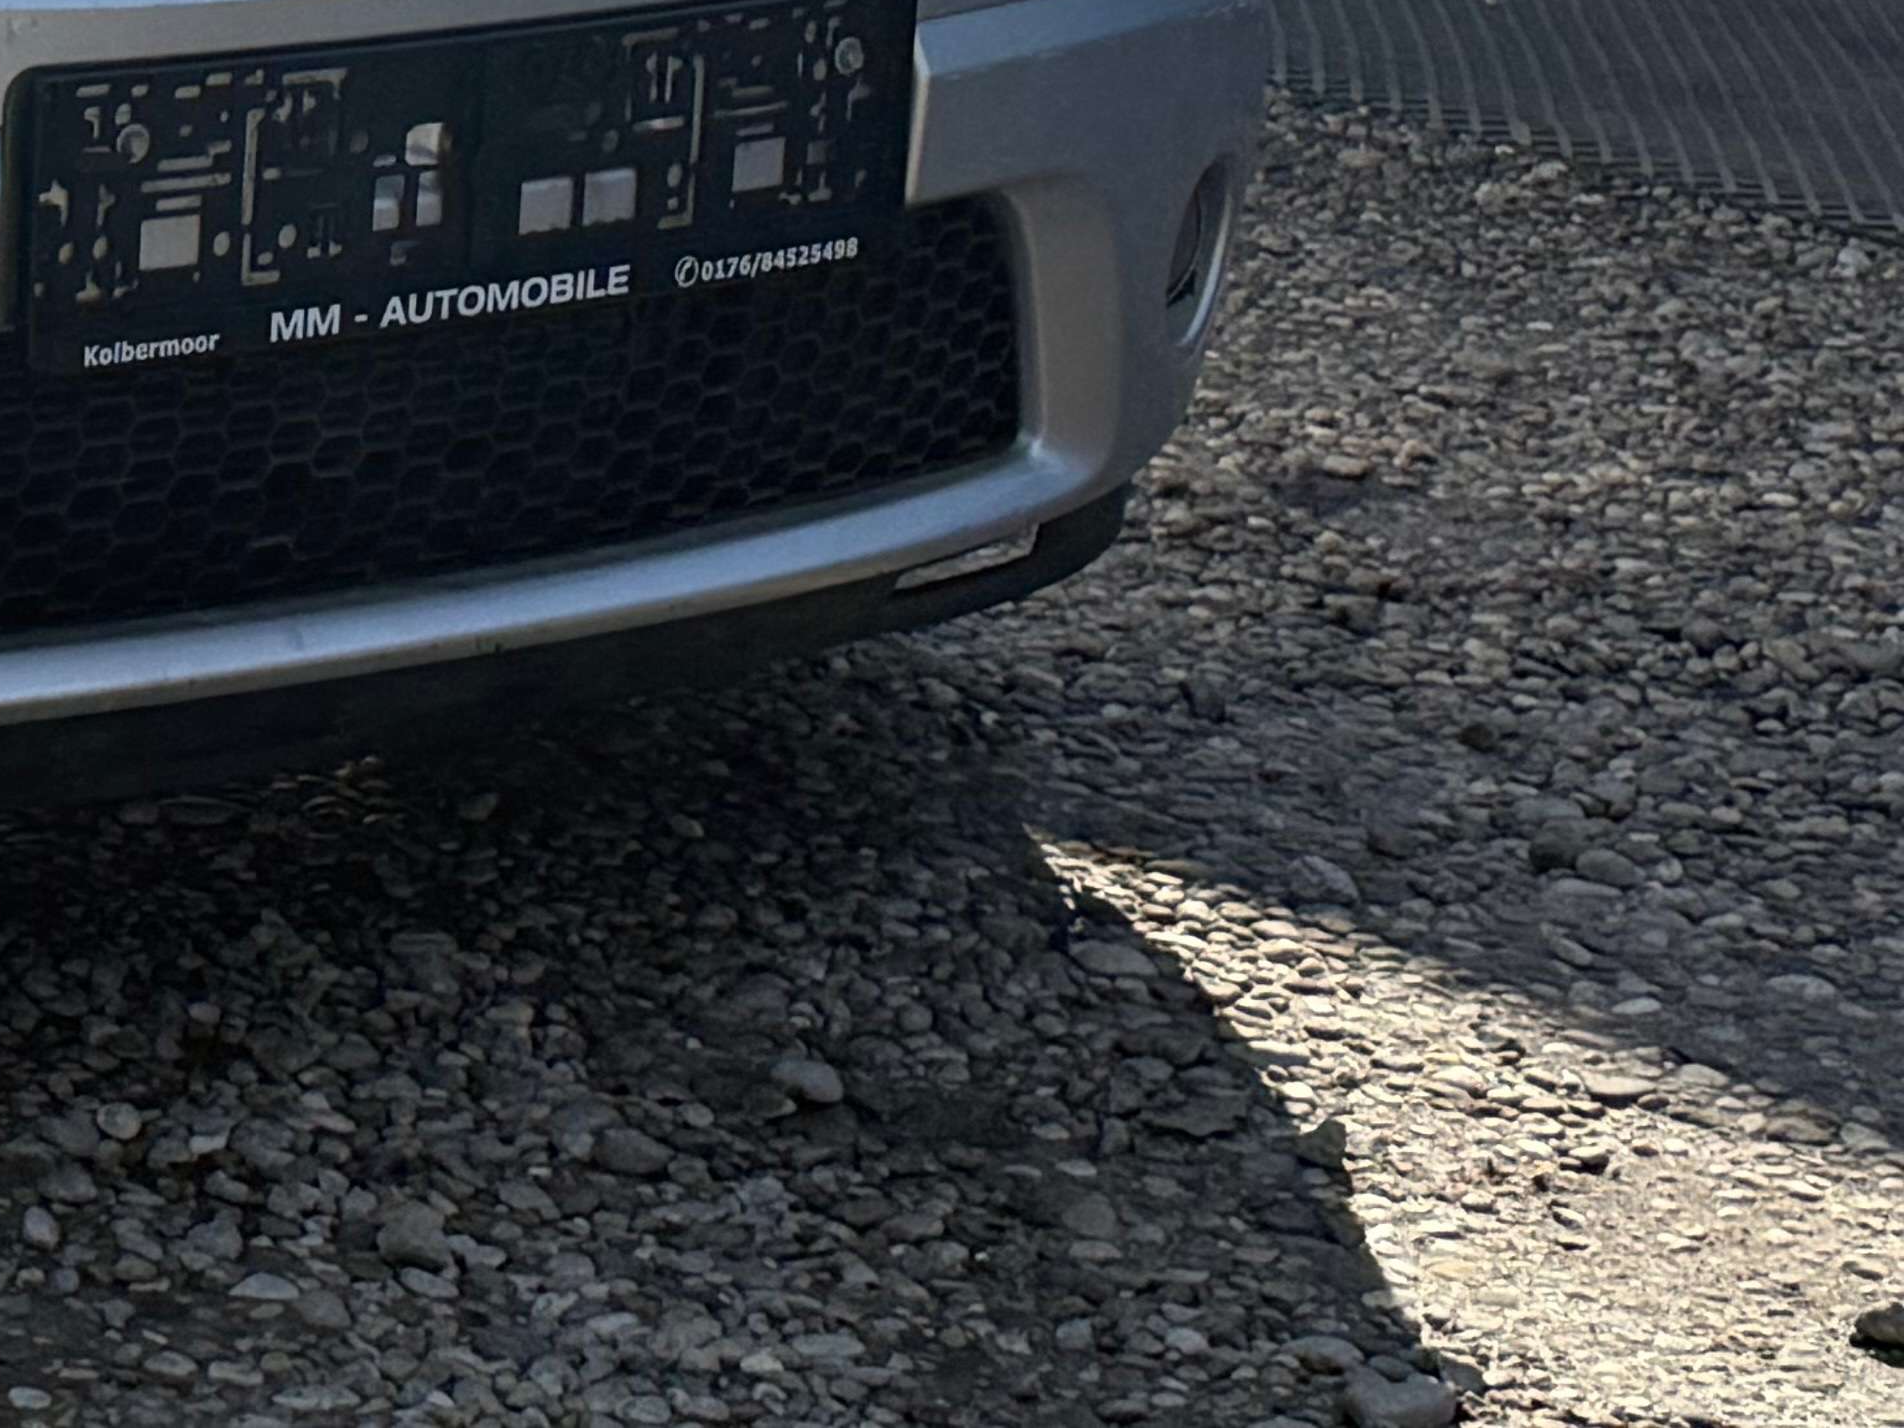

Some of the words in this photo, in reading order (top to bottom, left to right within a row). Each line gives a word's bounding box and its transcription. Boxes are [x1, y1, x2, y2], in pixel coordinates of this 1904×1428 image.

[84, 333, 220, 367] Kolbermoor
[270, 304, 340, 343] MM
[380, 264, 630, 328] AUTOMOBILE
[701, 237, 858, 281] 0176/84525498
